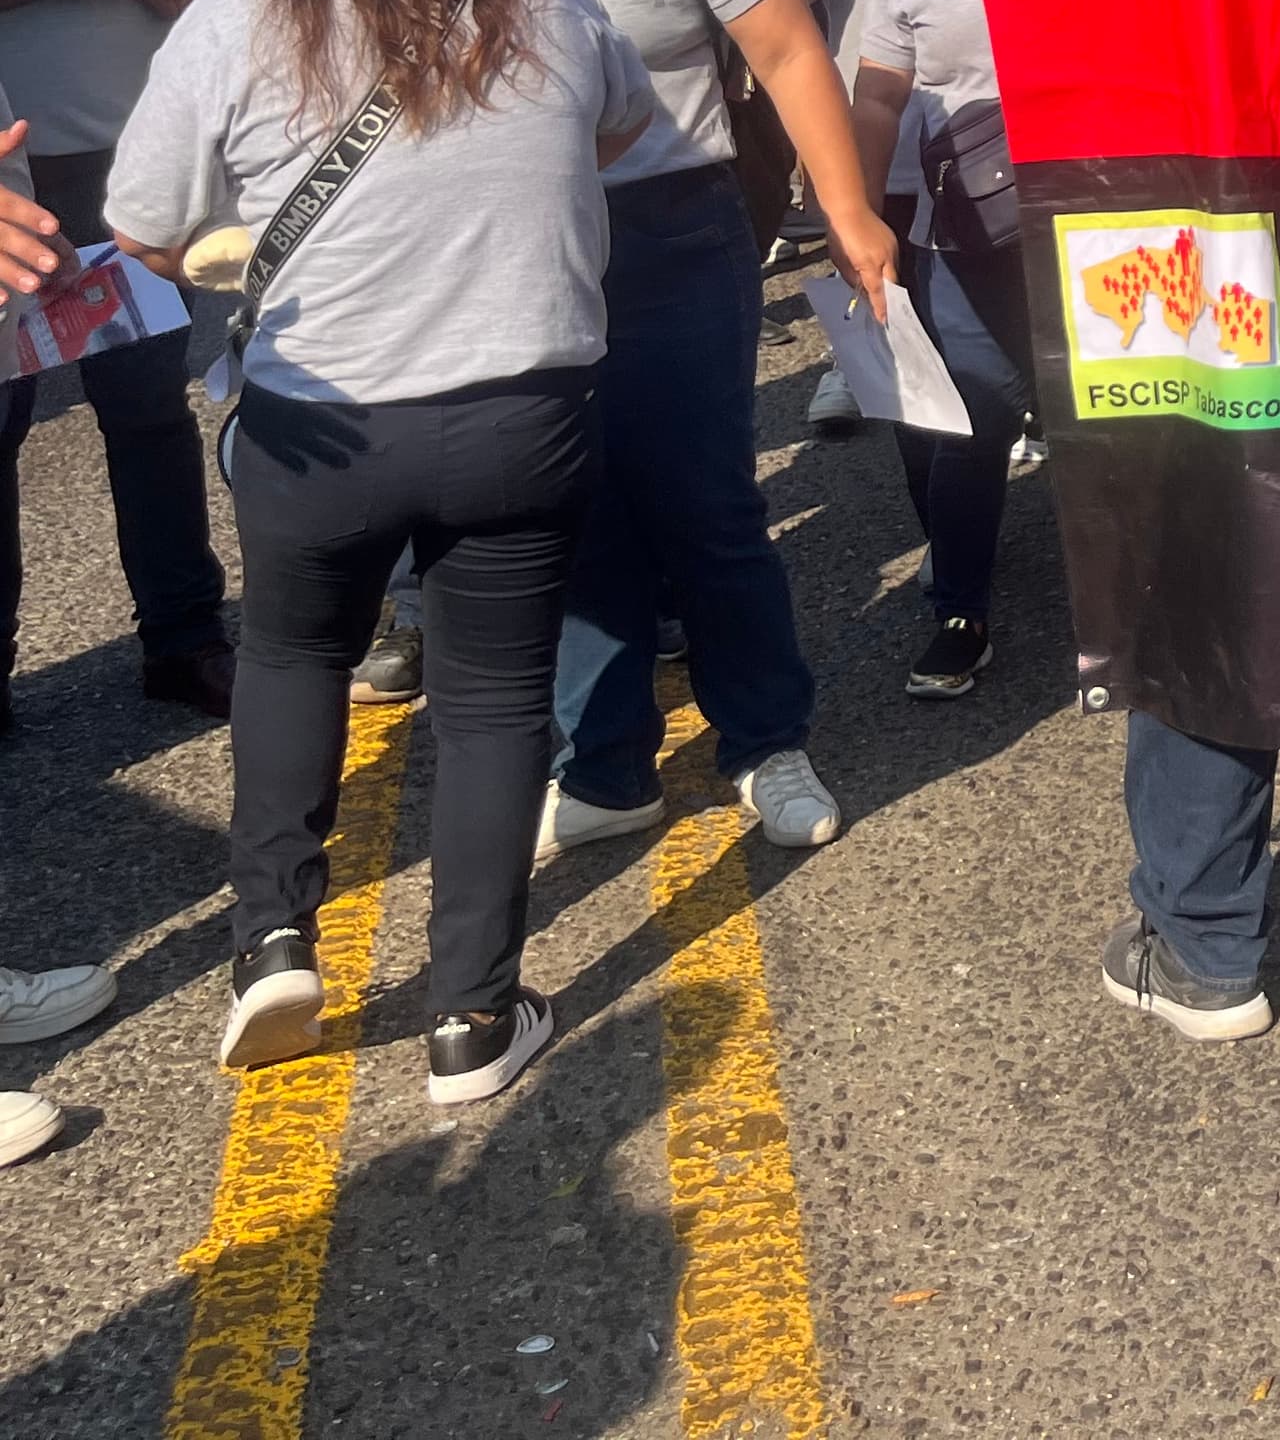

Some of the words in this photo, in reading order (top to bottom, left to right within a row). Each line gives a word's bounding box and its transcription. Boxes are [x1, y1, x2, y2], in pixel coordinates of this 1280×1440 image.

[269, 178, 339, 254] BIMBA
[321, 151, 351, 176] Y
[344, 83, 402, 153] LOLA
[1088, 380, 1190, 408] FSCISP
[263, 927, 301, 944] adidas
[434, 1023, 471, 1036] adidas
